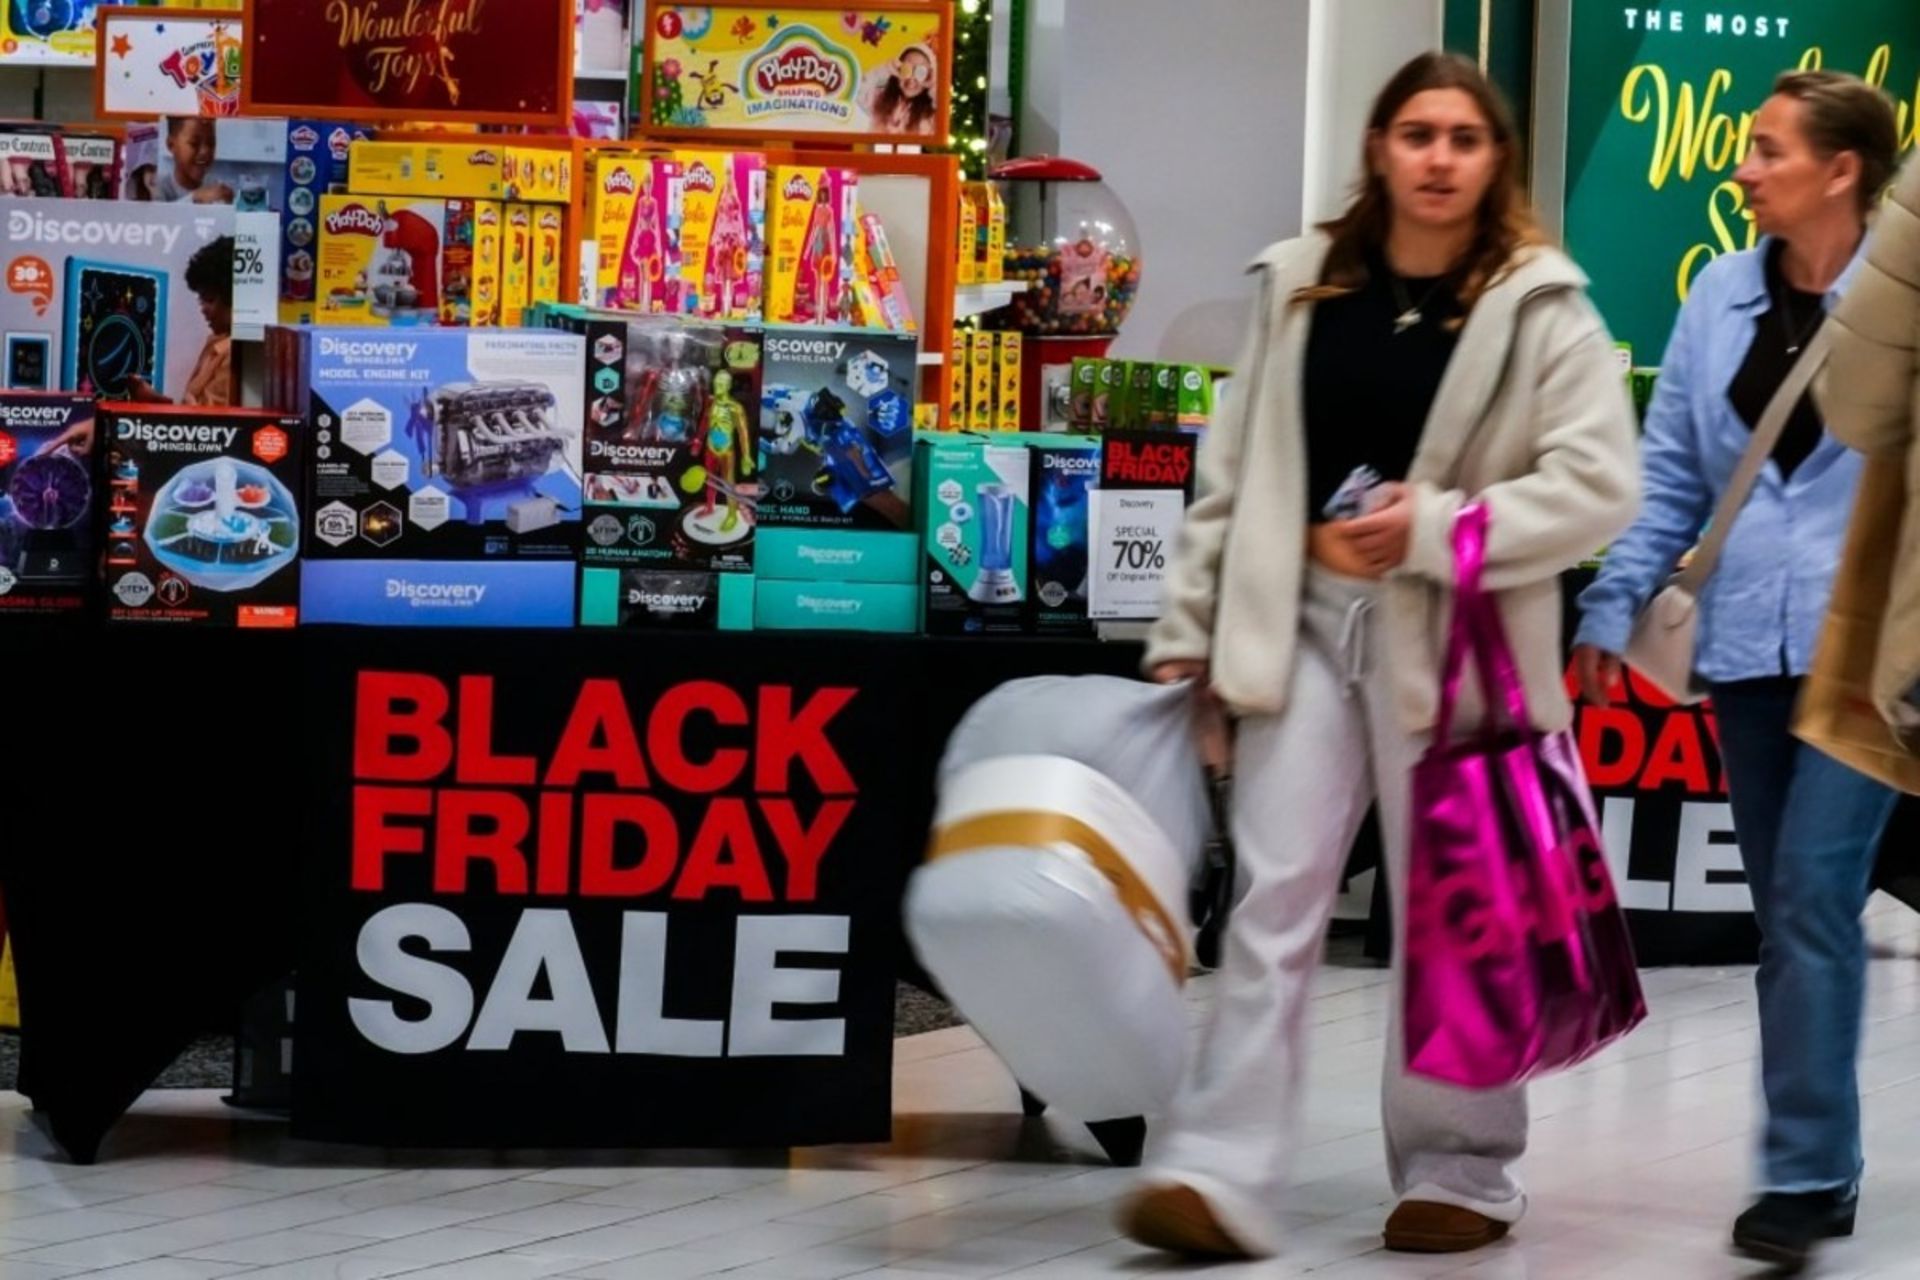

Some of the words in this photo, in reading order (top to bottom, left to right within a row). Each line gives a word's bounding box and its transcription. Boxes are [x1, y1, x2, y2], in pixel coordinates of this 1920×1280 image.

[326, 0, 481, 46] Wonderful
[1624, 9, 1683, 31] THE
[1705, 13, 1790, 37] MOST
[367, 46, 435, 93] Toys
[758, 54, 841, 88] Play-Doh
[777, 89, 822, 98] SHAPING
[747, 99, 848, 118] IMAGINATIONS
[9, 210, 183, 254] Discovery
[326, 207, 384, 234] Play-Doh
[319, 337, 418, 360] Discovery
[318, 368, 360, 379] MODEL
[363, 369, 407, 380] ENGINE
[410, 369, 431, 380] KIT
[117, 418, 238, 448] Discovery
[589, 441, 677, 464] Discovery
[1107, 440, 1191, 464] BLACK
[1106, 461, 1190, 483] FRIDAY
[779, 505, 810, 514] HAND
[1119, 498, 1154, 510] Discovery
[1115, 525, 1158, 538] SPECIAL
[598, 547, 630, 556] HUMAN
[631, 548, 673, 558] ANATOMY
[797, 545, 863, 562] Discovery
[1112, 539, 1165, 570] 70%
[1119, 572, 1147, 584] Original
[386, 579, 486, 602] Discovery
[628, 590, 705, 609] Discovery
[797, 595, 862, 611] Discovery
[353, 670, 860, 794] BLACK
[352, 785, 857, 901] FRIDAY
[347, 902, 851, 1058] SALE
